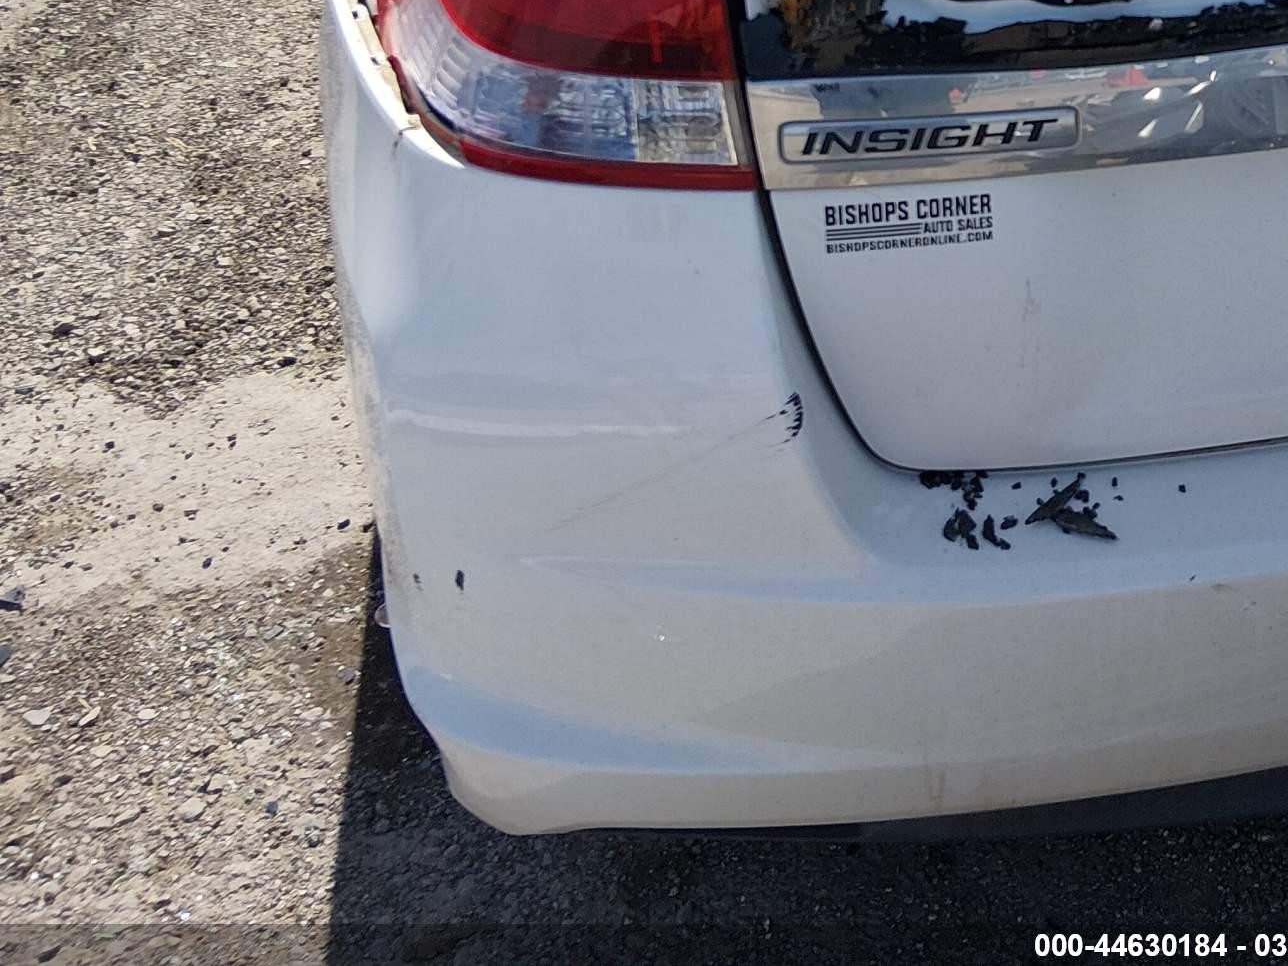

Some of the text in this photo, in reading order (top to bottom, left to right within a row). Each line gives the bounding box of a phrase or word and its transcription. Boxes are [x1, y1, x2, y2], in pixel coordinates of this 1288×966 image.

[801, 118, 1058, 156] INSIGHT
[825, 193, 992, 227] BISHOPS CORNER
[923, 216, 993, 234] AUTO SALES
[826, 231, 993, 254] BISHOPSCORNERONLINE.COM
